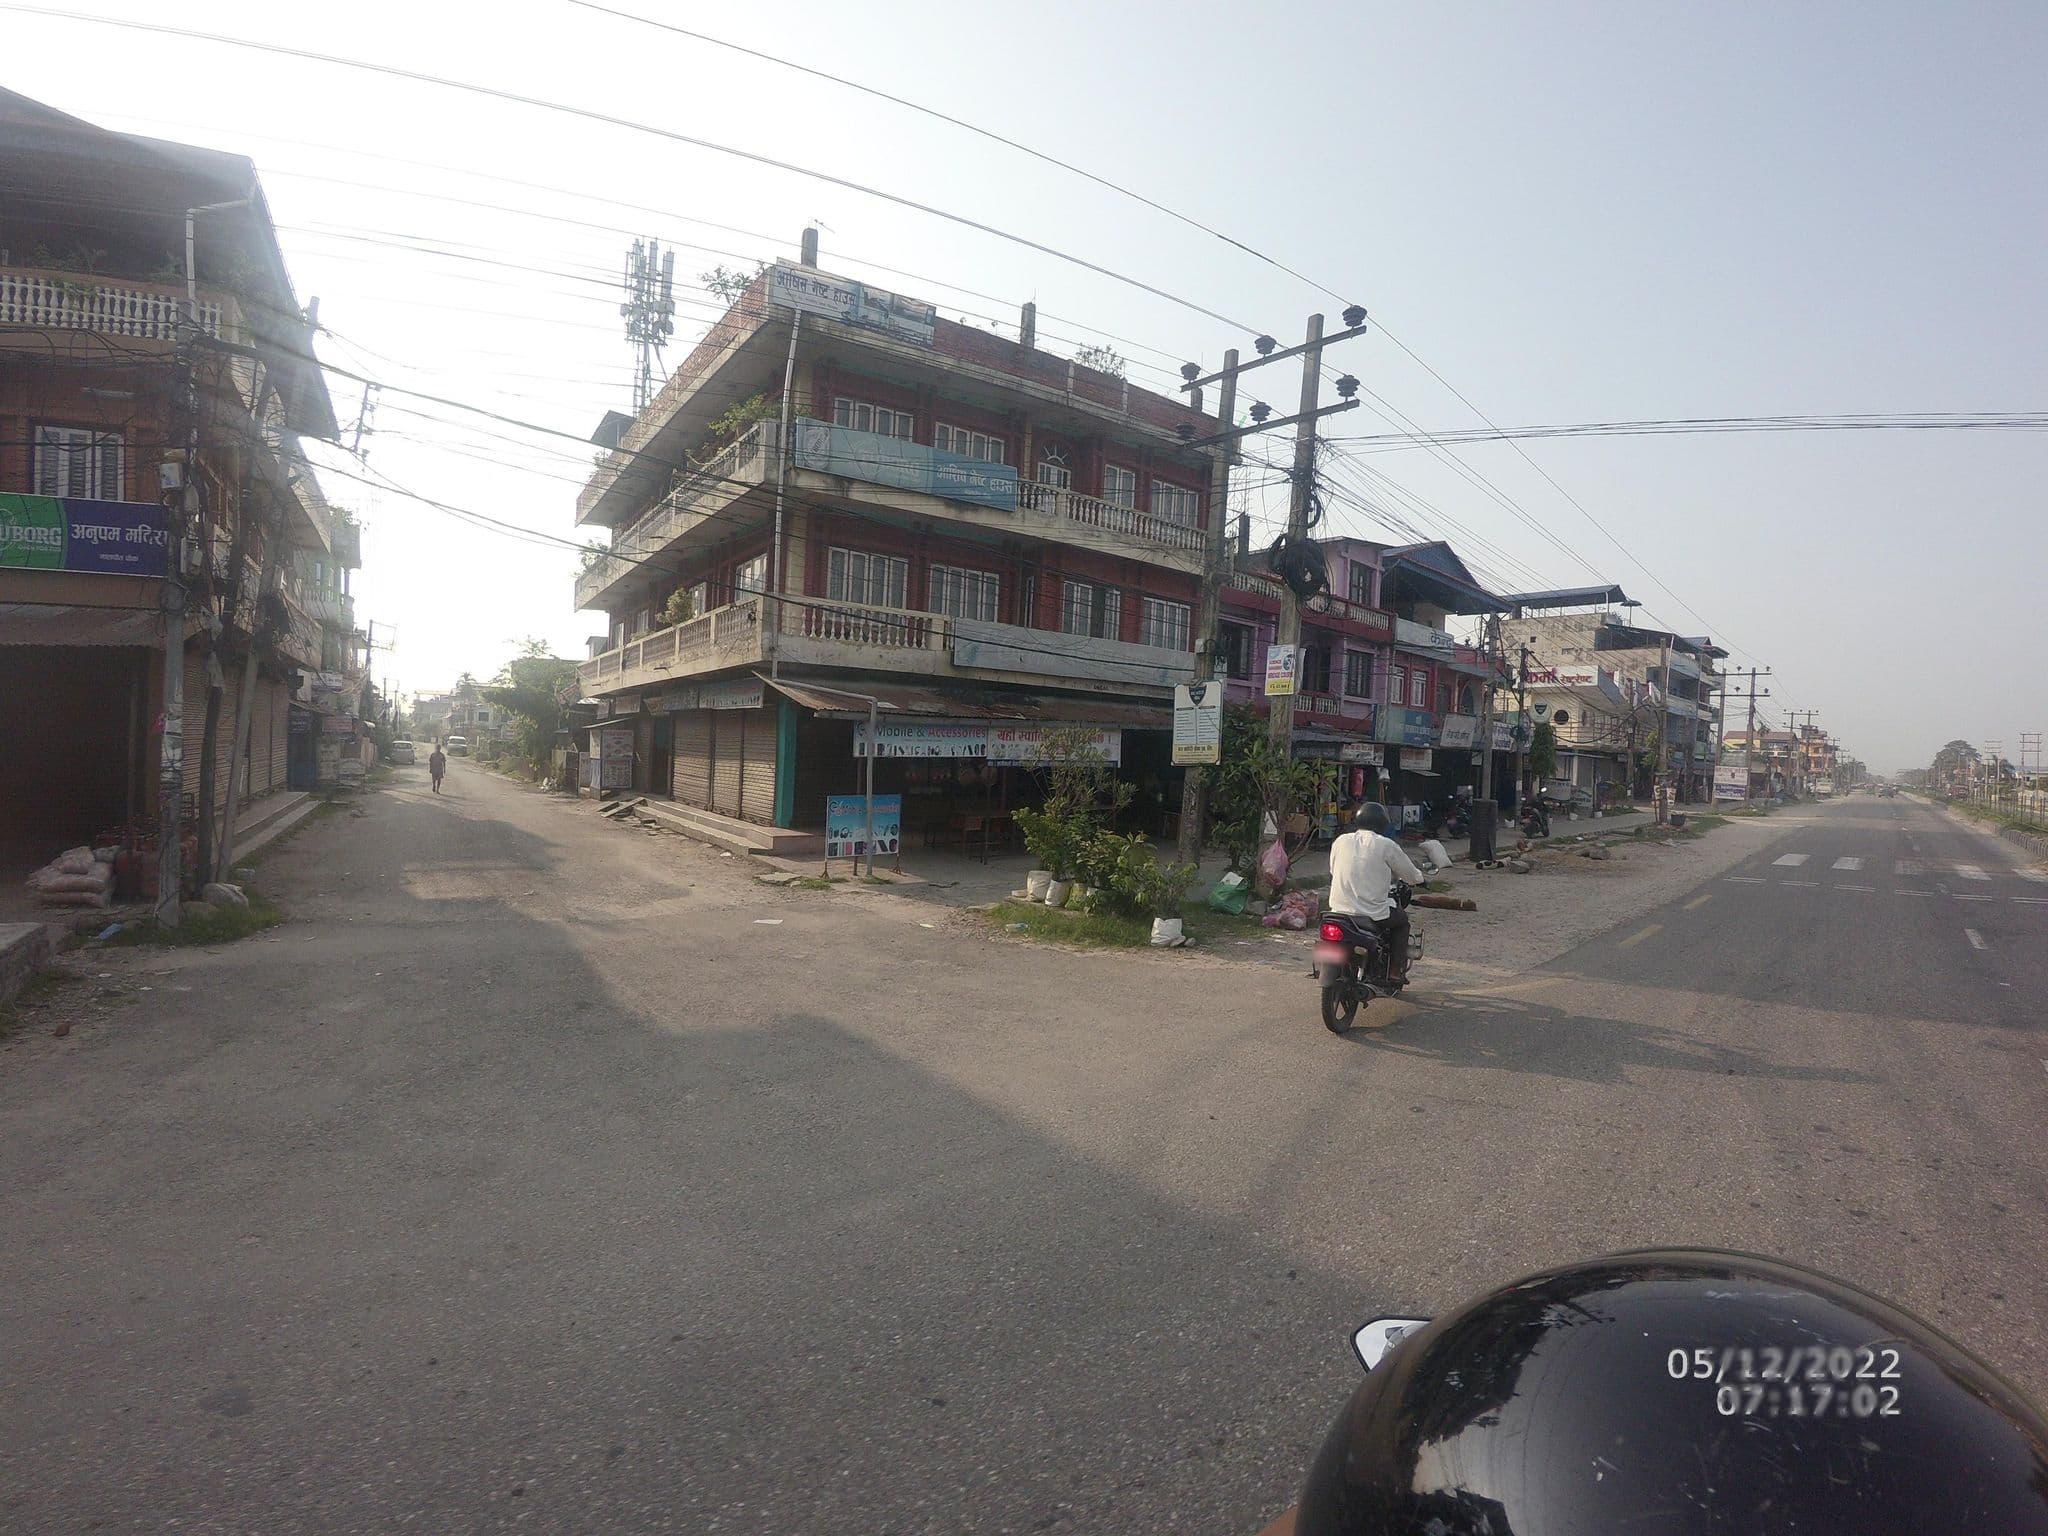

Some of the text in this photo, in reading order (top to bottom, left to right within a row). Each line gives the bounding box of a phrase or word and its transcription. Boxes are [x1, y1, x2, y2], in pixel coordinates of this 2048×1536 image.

[0, 525, 61, 546] UBORG
[71, 524, 121, 545] अनुपम
[928, 726, 986, 738] Accessories
